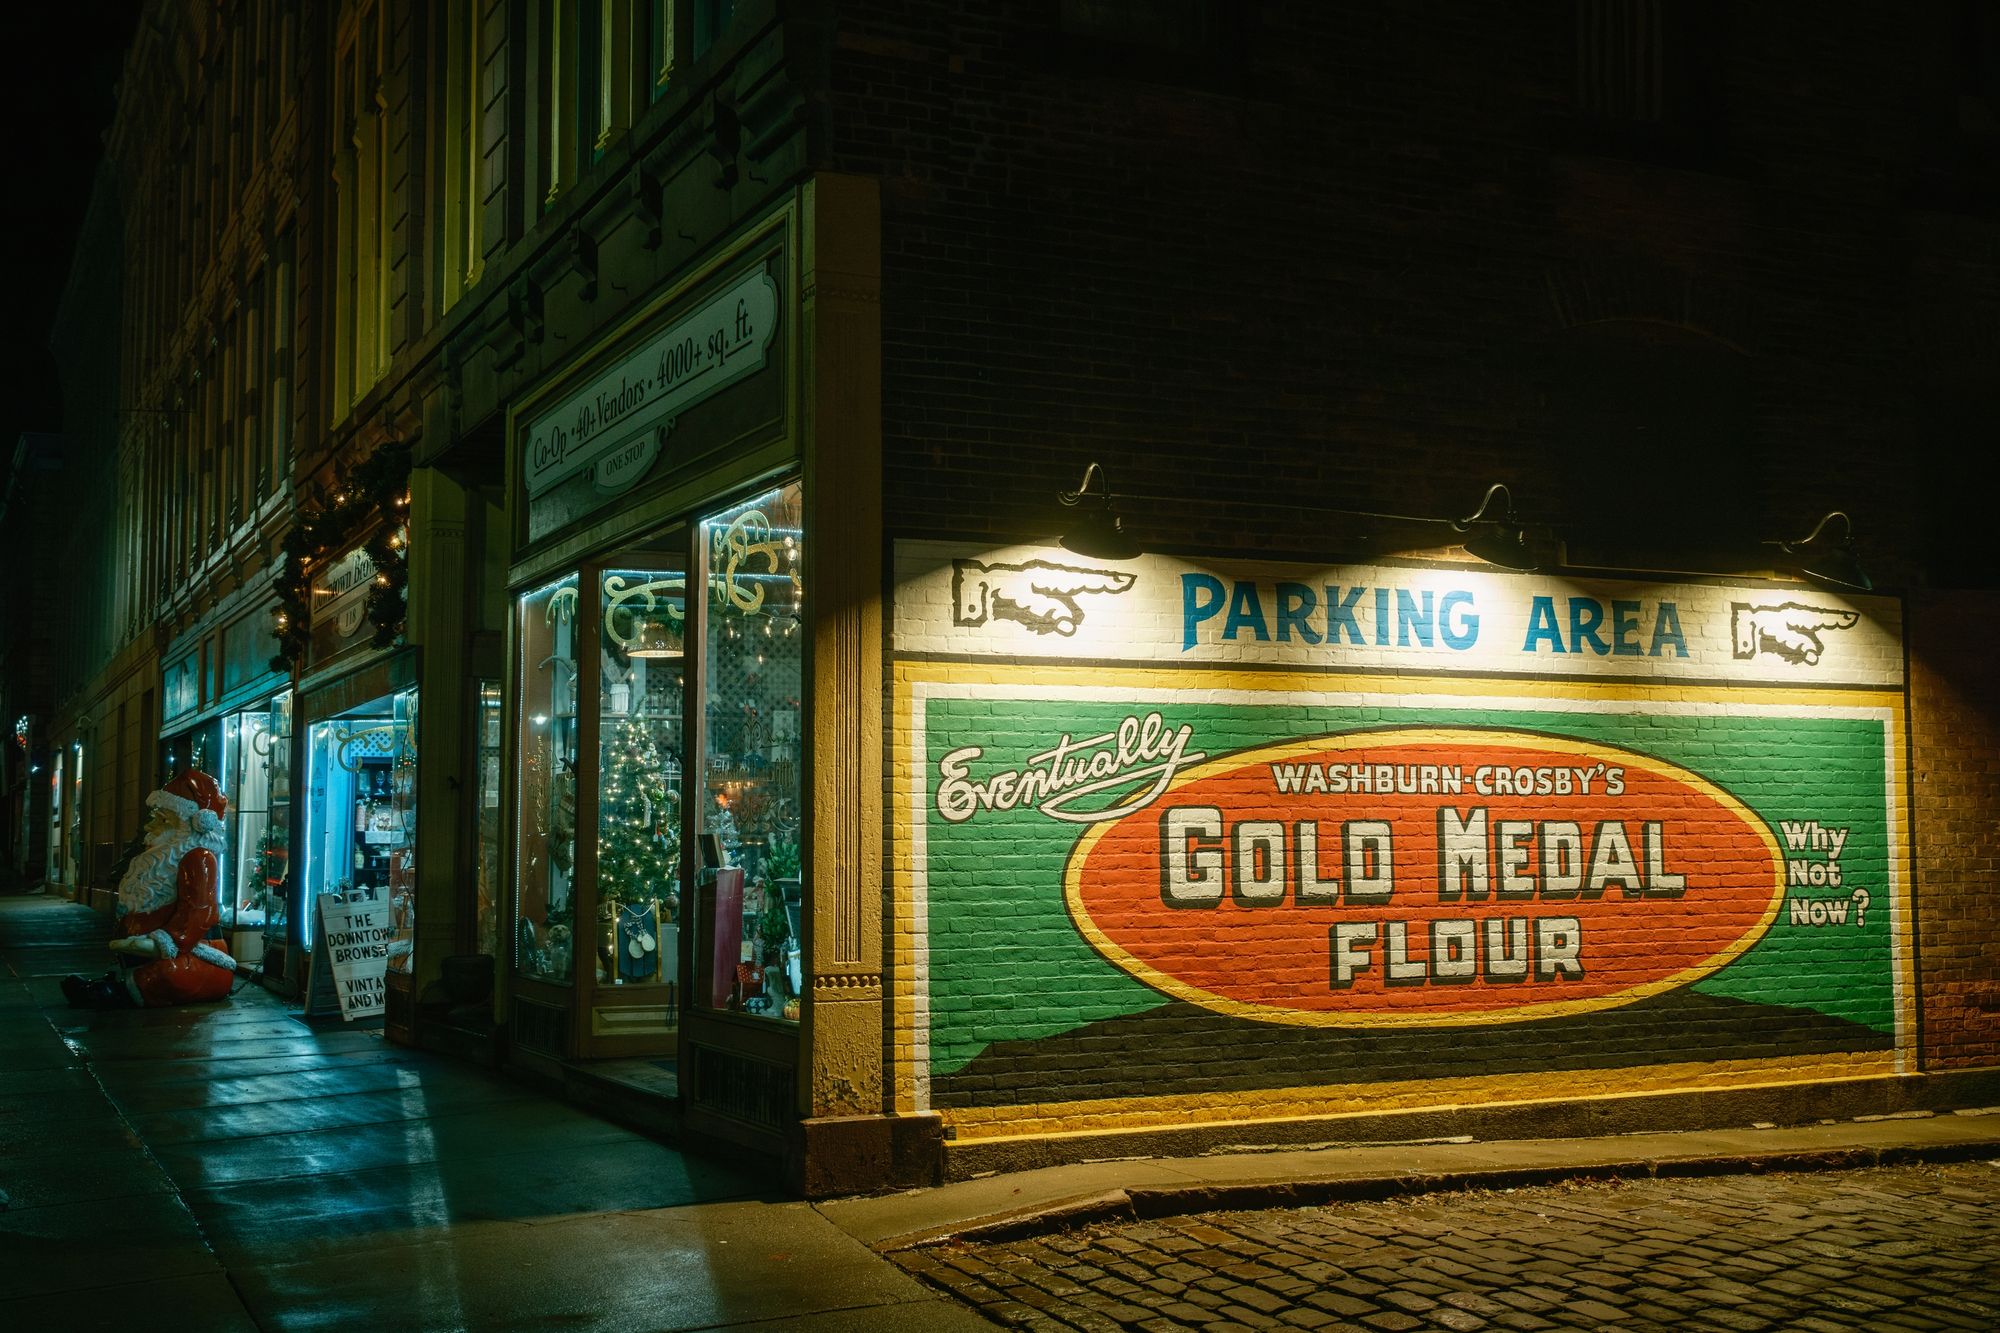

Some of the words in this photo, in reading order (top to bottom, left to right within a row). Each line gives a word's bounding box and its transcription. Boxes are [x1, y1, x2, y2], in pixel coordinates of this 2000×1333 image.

[534, 426, 567, 469] Co-Op
[596, 377, 645, 427] Vendors
[657, 337, 702, 390] 4000+
[707, 328, 729, 368] sq.
[735, 298, 753, 344] ft.
[606, 453, 624, 476] ONE
[624, 442, 645, 468] STOP
[1181, 572, 1480, 652] PARKING
[1522, 595, 1690, 658] AREA
[937, 711, 1207, 824] Eventually
[1270, 761, 1626, 797] WASHBURN-CROSBY'S
[1160, 805, 1396, 908] GOLD
[1437, 805, 1687, 901] MEDAL
[1779, 820, 1850, 860] Why
[1789, 858, 1842, 888] Not
[328, 928, 390, 947] DOWNTOW
[345, 913, 373, 929] THE
[1329, 915, 1585, 990] FLOUR
[345, 976, 386, 993] VINTA
[348, 994, 373, 1009] AND
